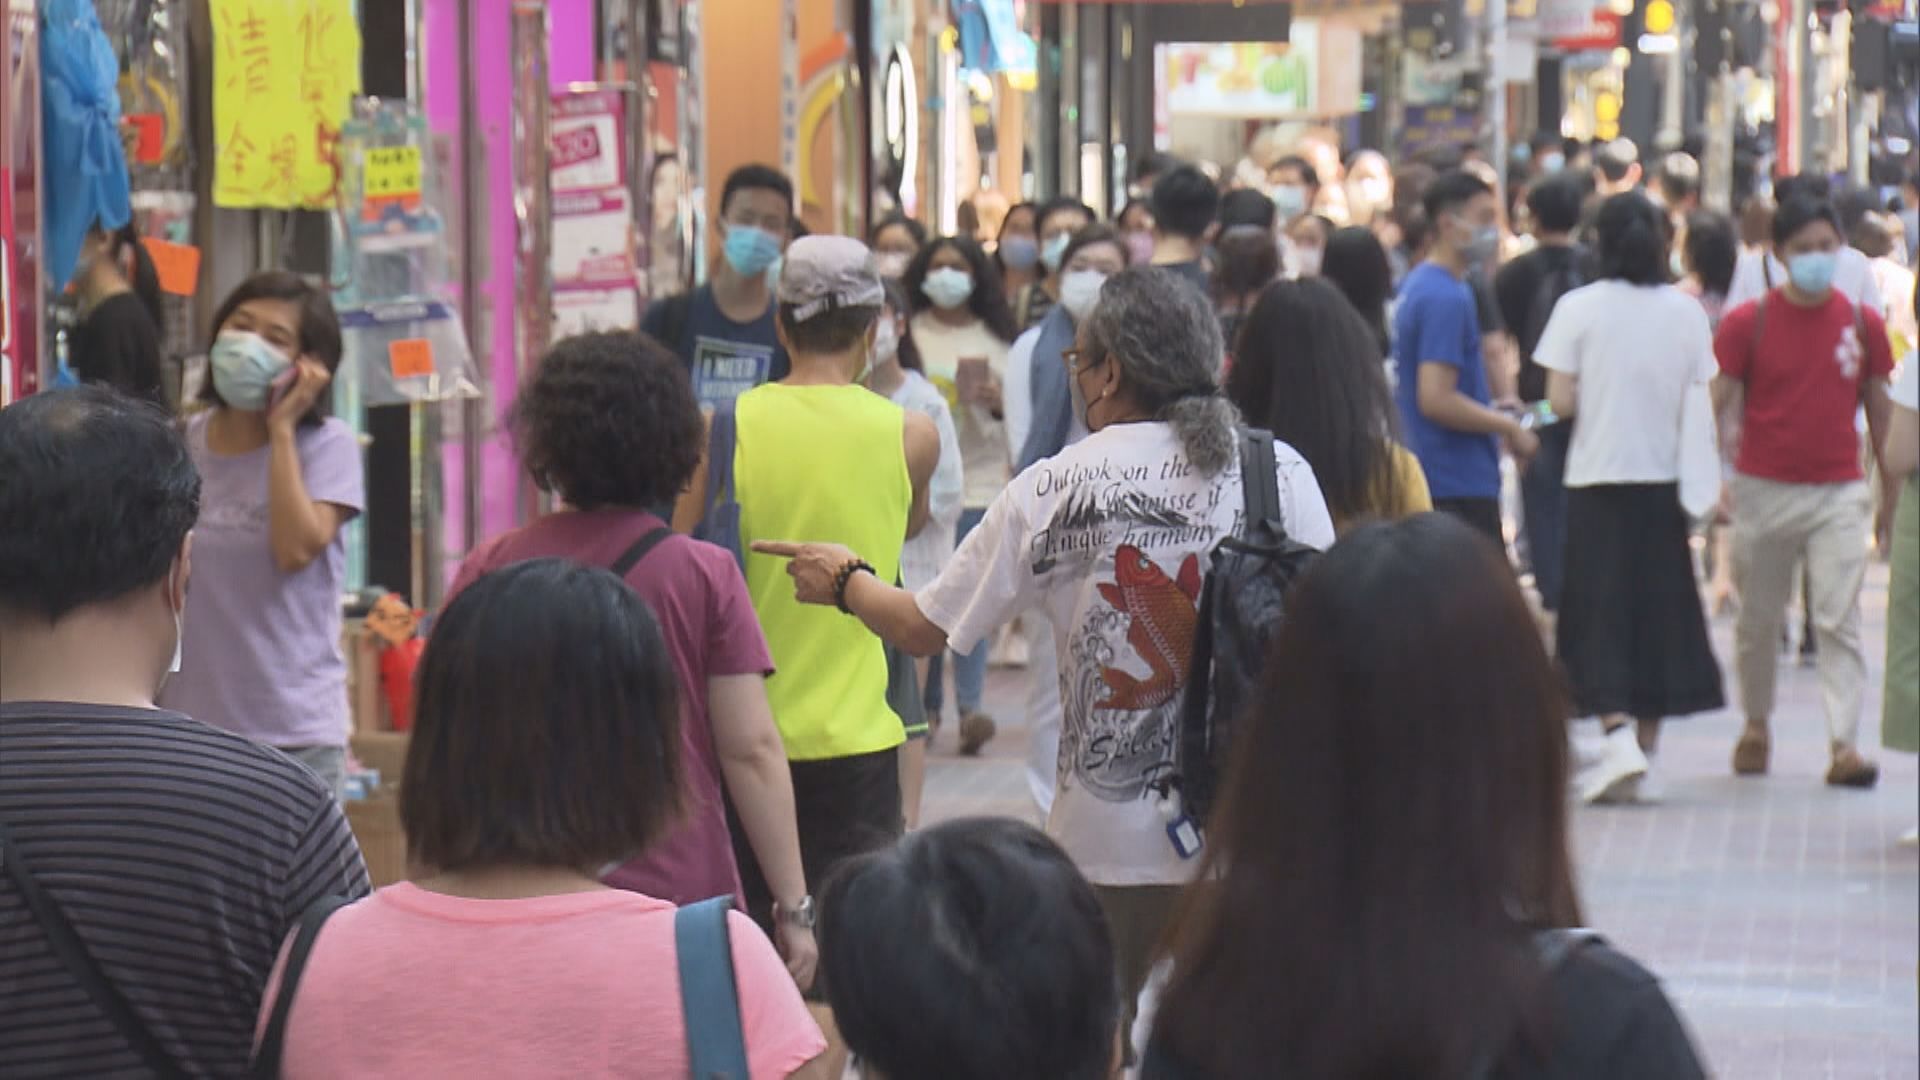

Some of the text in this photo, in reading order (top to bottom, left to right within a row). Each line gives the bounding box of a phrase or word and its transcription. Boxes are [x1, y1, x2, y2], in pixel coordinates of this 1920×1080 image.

[1037, 454, 1192, 497] Outlook on the
[1121, 520, 1217, 552] harmony
